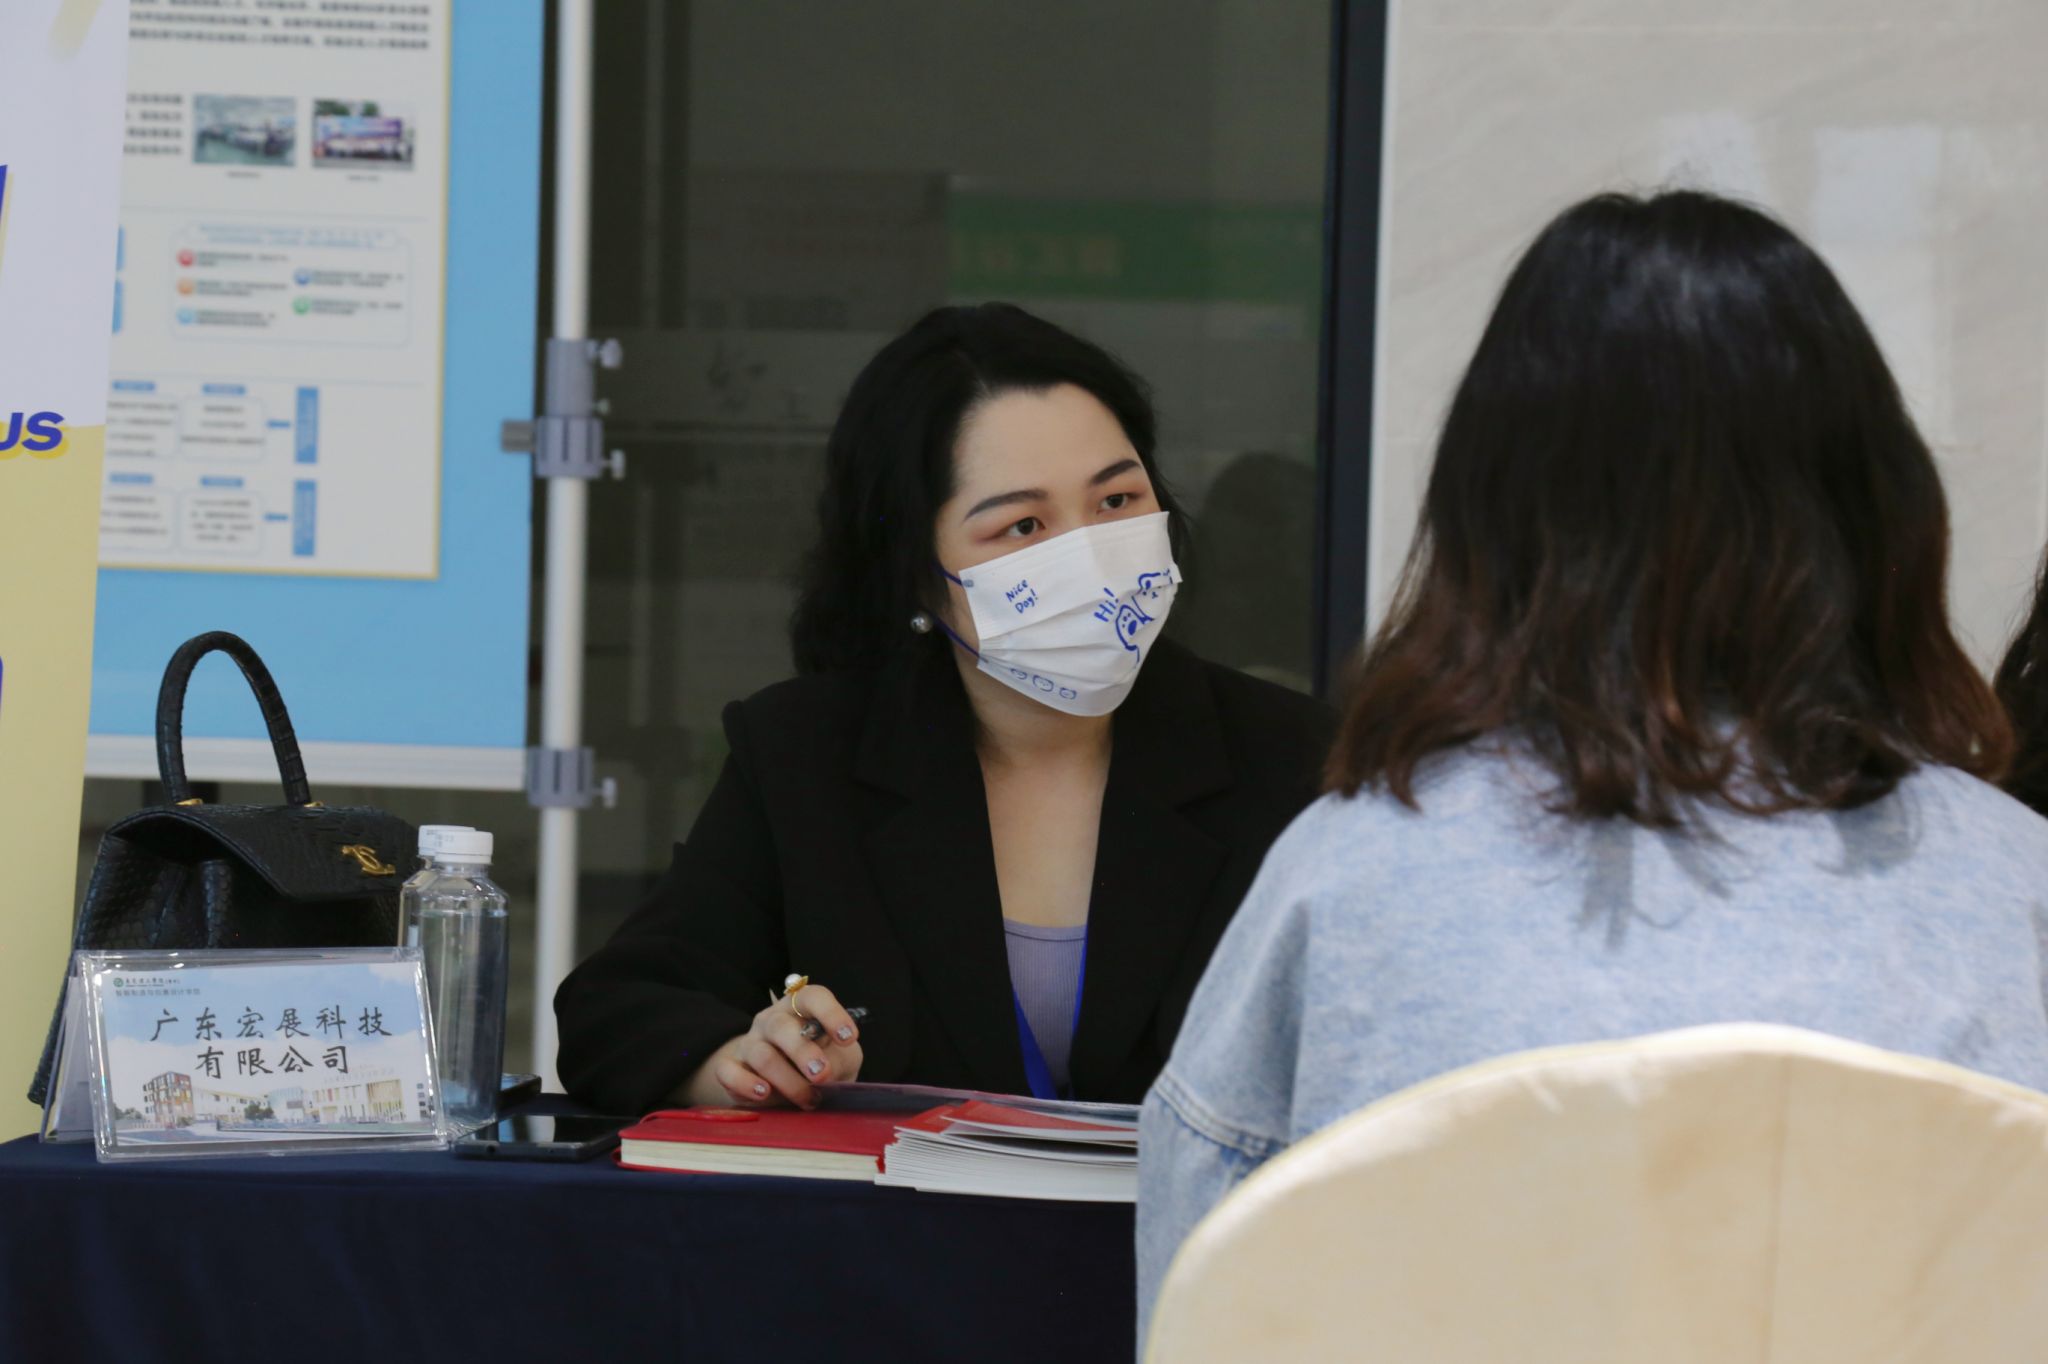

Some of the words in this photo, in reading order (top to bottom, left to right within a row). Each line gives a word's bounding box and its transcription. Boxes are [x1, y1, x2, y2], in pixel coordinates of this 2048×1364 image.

[1005, 579, 1028, 602] Nice
[1015, 588, 1038, 614] Day!
[1094, 587, 1119, 622] Hi!
[150, 1005, 393, 1042] 广东宏展科技
[195, 1046, 350, 1080] 有限公司
